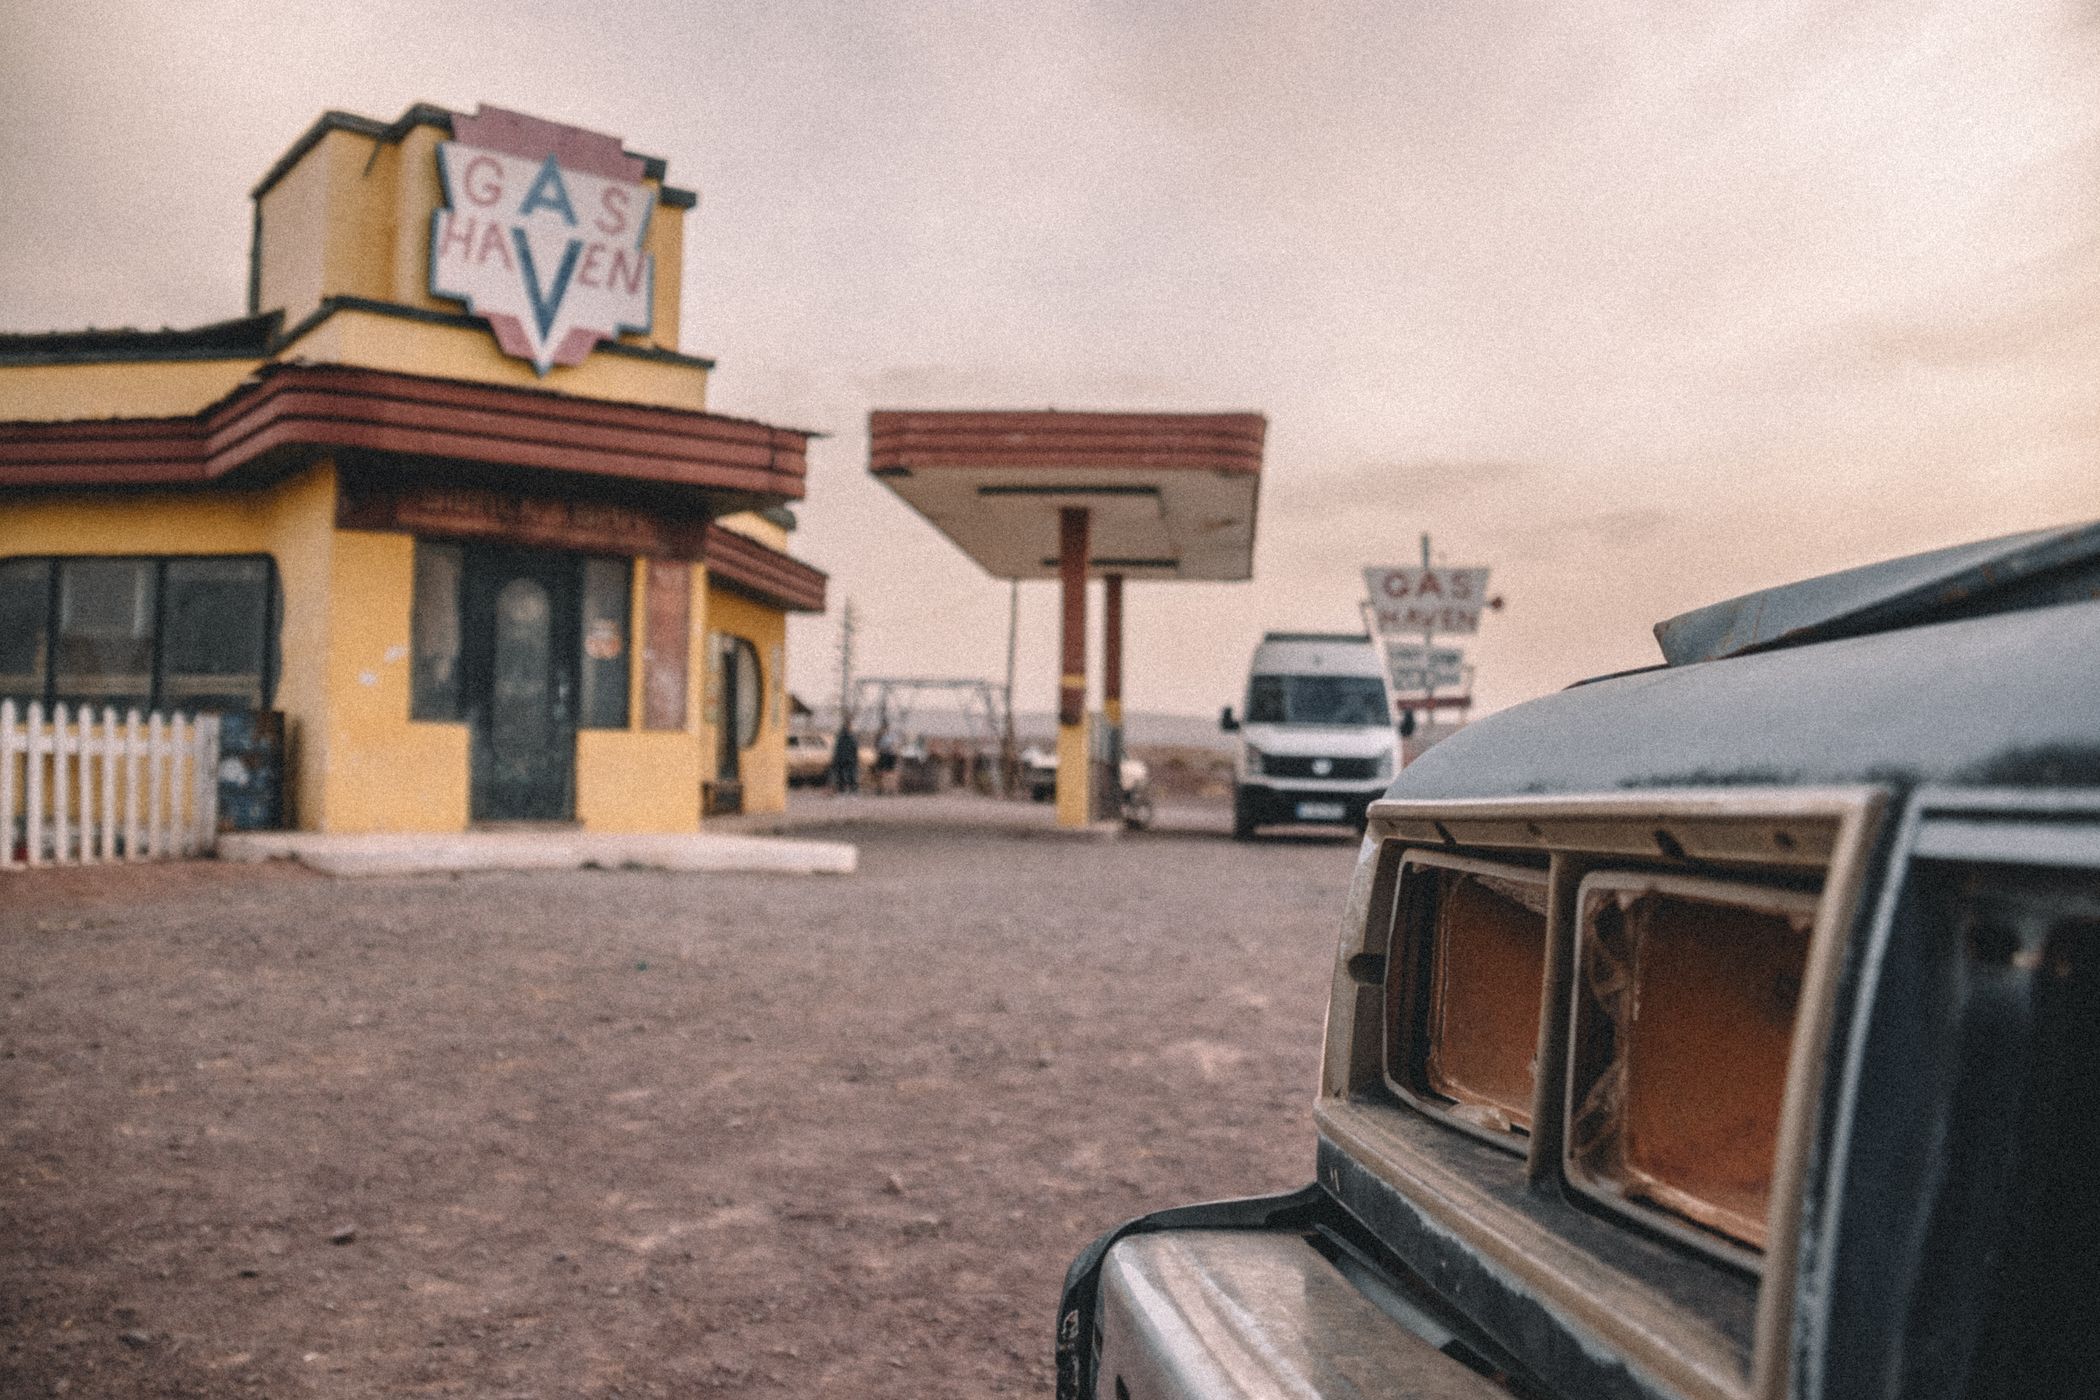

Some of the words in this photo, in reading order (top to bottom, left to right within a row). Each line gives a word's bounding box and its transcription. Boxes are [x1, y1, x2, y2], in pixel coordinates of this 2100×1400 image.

[462, 153, 630, 235] GAS
[440, 214, 646, 345] HAVEN
[1382, 570, 1473, 600] GAS
